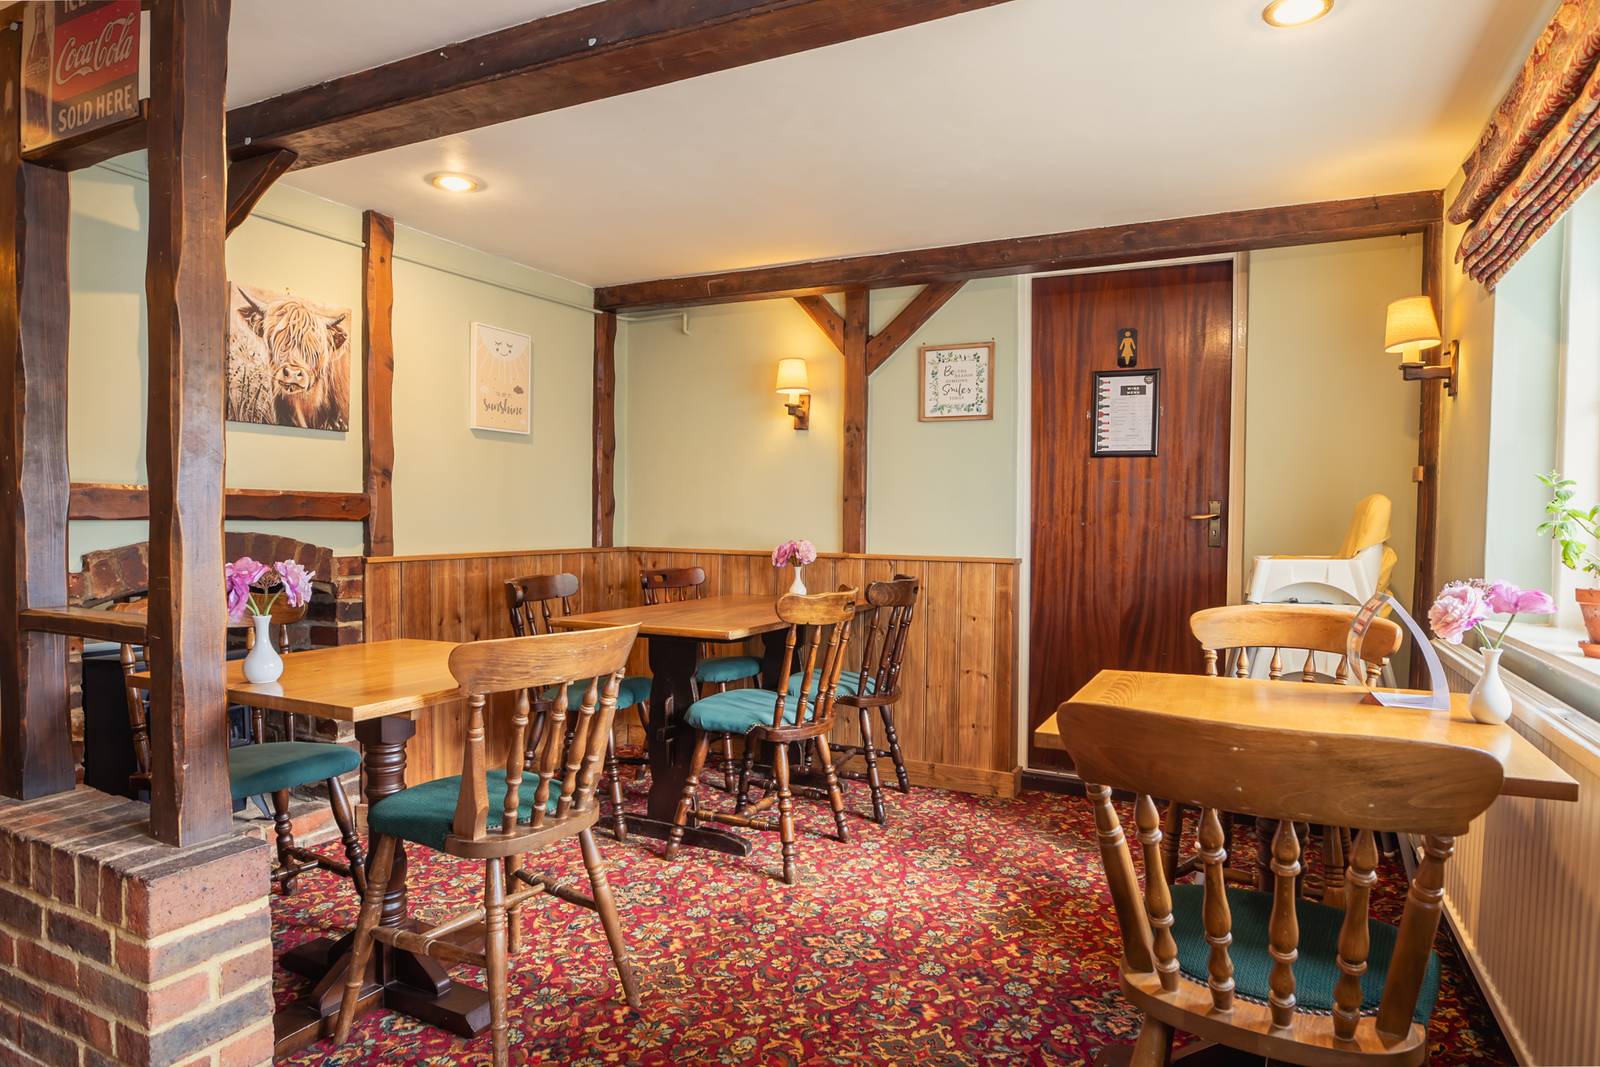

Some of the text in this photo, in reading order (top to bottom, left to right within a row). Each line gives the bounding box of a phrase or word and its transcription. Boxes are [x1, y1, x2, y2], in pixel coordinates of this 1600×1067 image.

[58, 84, 134, 132] SOLD HERE
[943, 365, 955, 377] Be
[942, 383, 972, 396] Smiles
